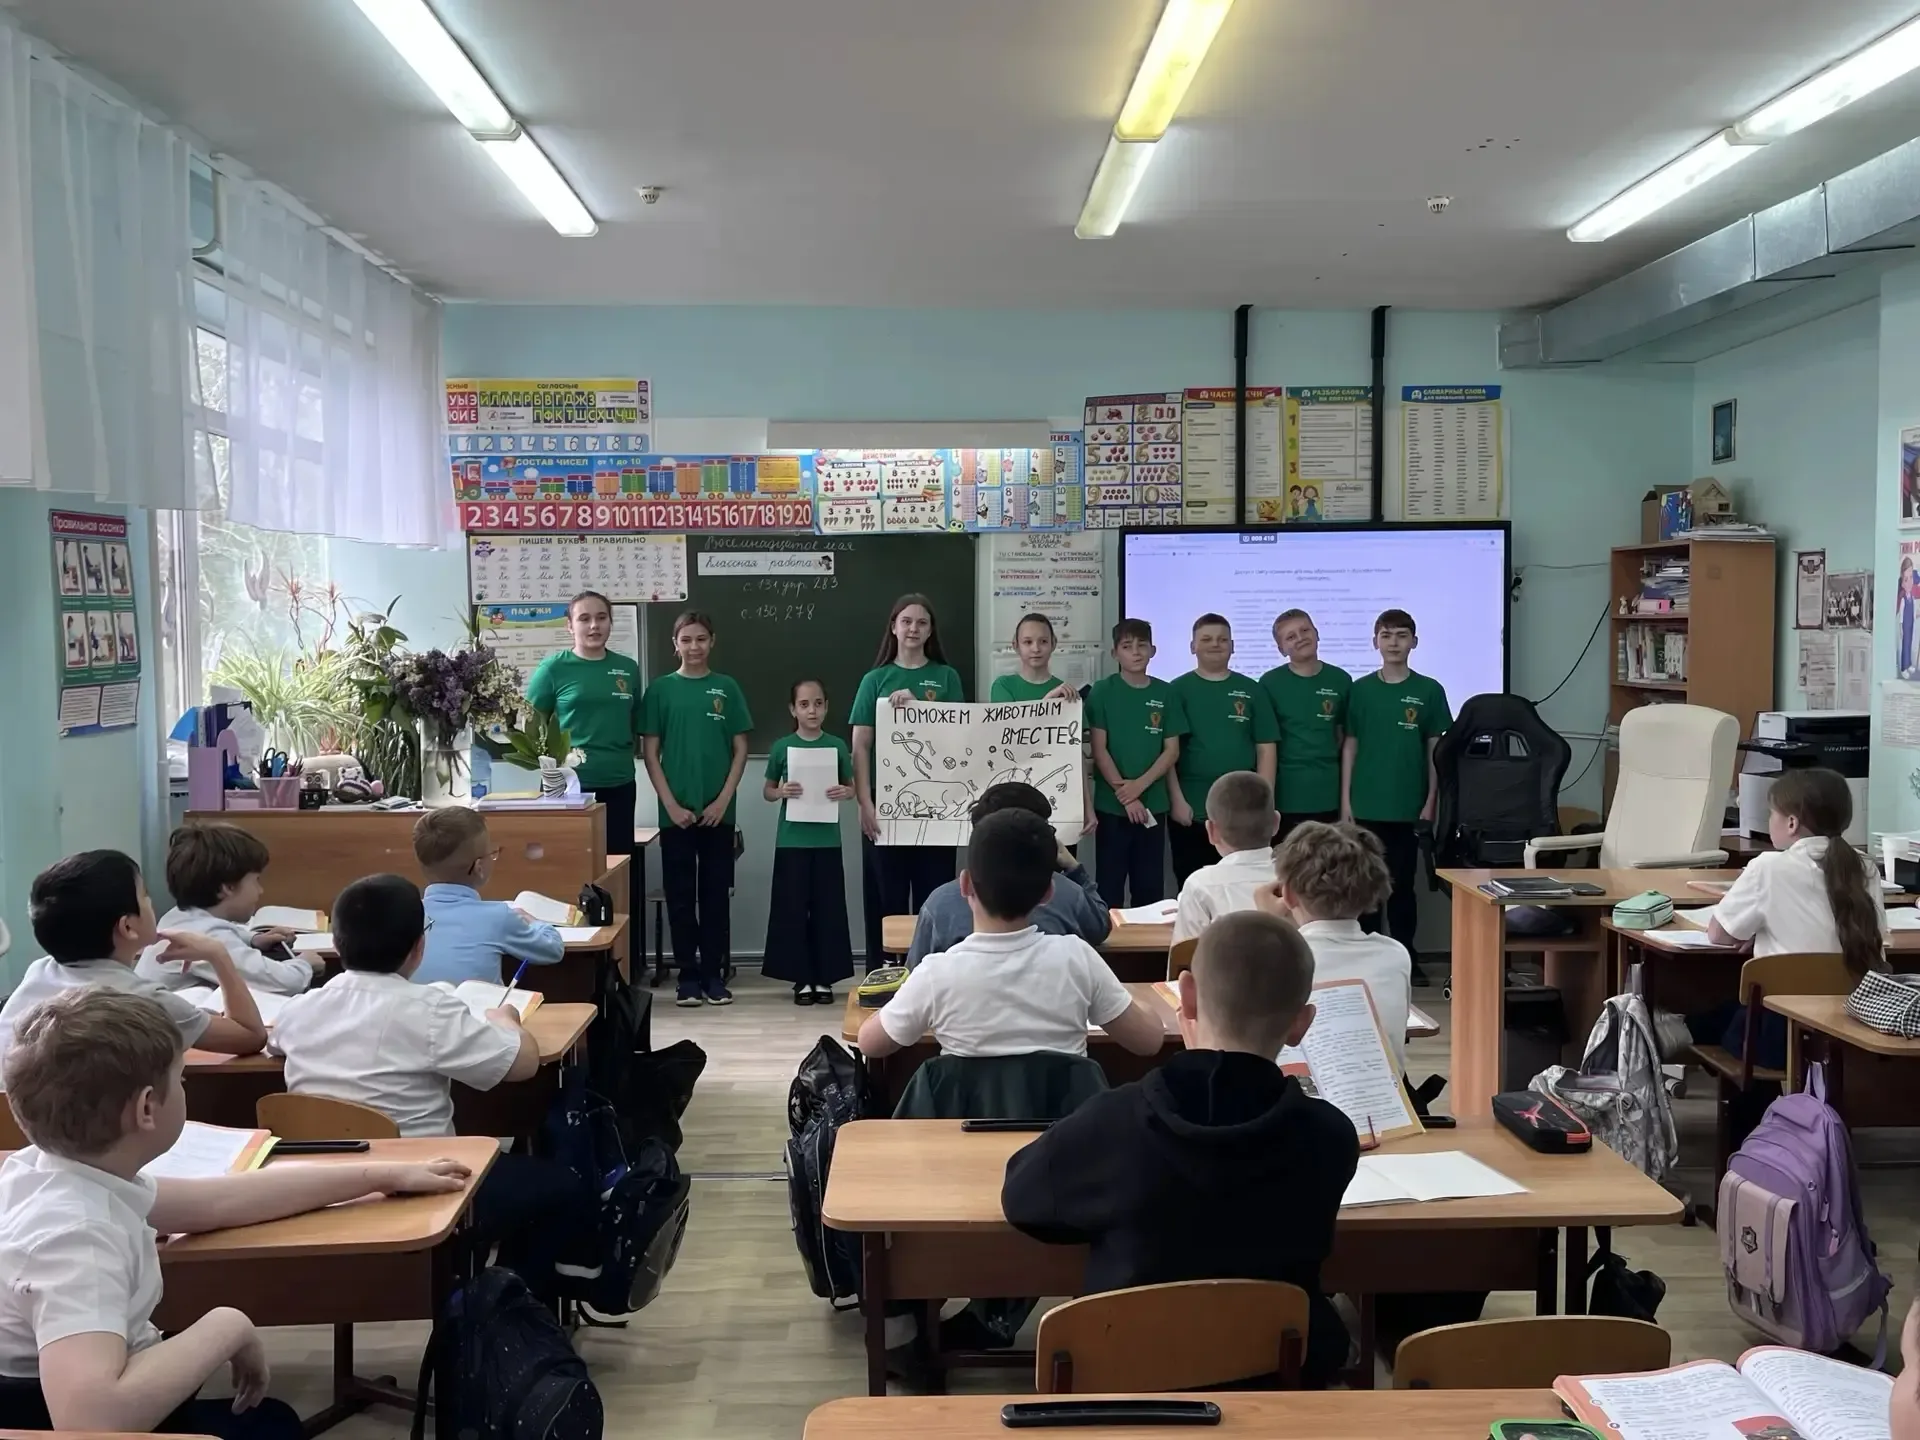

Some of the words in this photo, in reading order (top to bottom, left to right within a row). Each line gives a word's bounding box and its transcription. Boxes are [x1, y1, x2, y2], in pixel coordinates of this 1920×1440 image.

[1289, 414, 1297, 425] 1
[1050, 434, 1071, 442] НИЯ
[1115, 424, 1129, 443] 3
[1165, 423, 1179, 443] 4
[464, 437, 472, 451] 1
[482, 436, 493, 451] 2
[505, 437, 515, 451] 3
[527, 436, 536, 451] 4
[548, 436, 557, 451] 5
[569, 436, 579, 451] 6
[591, 436, 600, 451] 7
[612, 436, 621, 451] 8
[634, 436, 643, 451] 9
[1032, 451, 1039, 459] 4
[1057, 448, 1064, 457] 5
[1087, 445, 1100, 464] 5
[1135, 442, 1149, 464] 6
[515, 458, 554, 466] СОСТАВ
[556, 458, 589, 466] ЧИСЕЛ
[1289, 462, 1297, 474] 3
[1116, 464, 1130, 484] 7
[1165, 463, 1179, 483] 8
[953, 487, 960, 496] 6
[979, 492, 986, 501] 7
[1005, 487, 1012, 496] 8
[1031, 490, 1038, 500] 9
[1057, 487, 1066, 495] 10
[1087, 485, 1101, 505] 9
[1135, 484, 1160, 504] 10
[467, 506, 482, 527] 2
[486, 506, 500, 527] 3
[503, 506, 519, 527] 4
[523, 506, 536, 527] 5
[540, 506, 556, 527] 6
[559, 506, 573, 527] 7
[577, 505, 592, 527] 8
[595, 505, 610, 527] 9
[612, 506, 629, 526] 10
[632, 506, 648, 526] 11
[650, 506, 666, 526] 12
[667, 506, 685, 526] 13
[686, 506, 703, 526] 14
[703, 506, 721, 526] 15
[722, 506, 739, 526] 16
[740, 505, 757, 526] 17
[758, 505, 775, 526] 18
[777, 505, 793, 525] 19
[795, 505, 812, 525] 20
[865, 506, 871, 514] 6
[892, 505, 898, 513] 4
[53, 515, 98, 531] Правильная
[98, 523, 124, 534] осанка
[519, 537, 553, 545] ПИШЕМ
[593, 536, 646, 544] ПРАВИЛЬНО
[705, 555, 758, 568] Классная
[768, 554, 812, 571] работа
[813, 576, 839, 590] 283
[784, 603, 815, 621] 278
[894, 706, 970, 724] ПОМОЖЕМ
[982, 702, 1062, 723] ЖИВОТНЫМ
